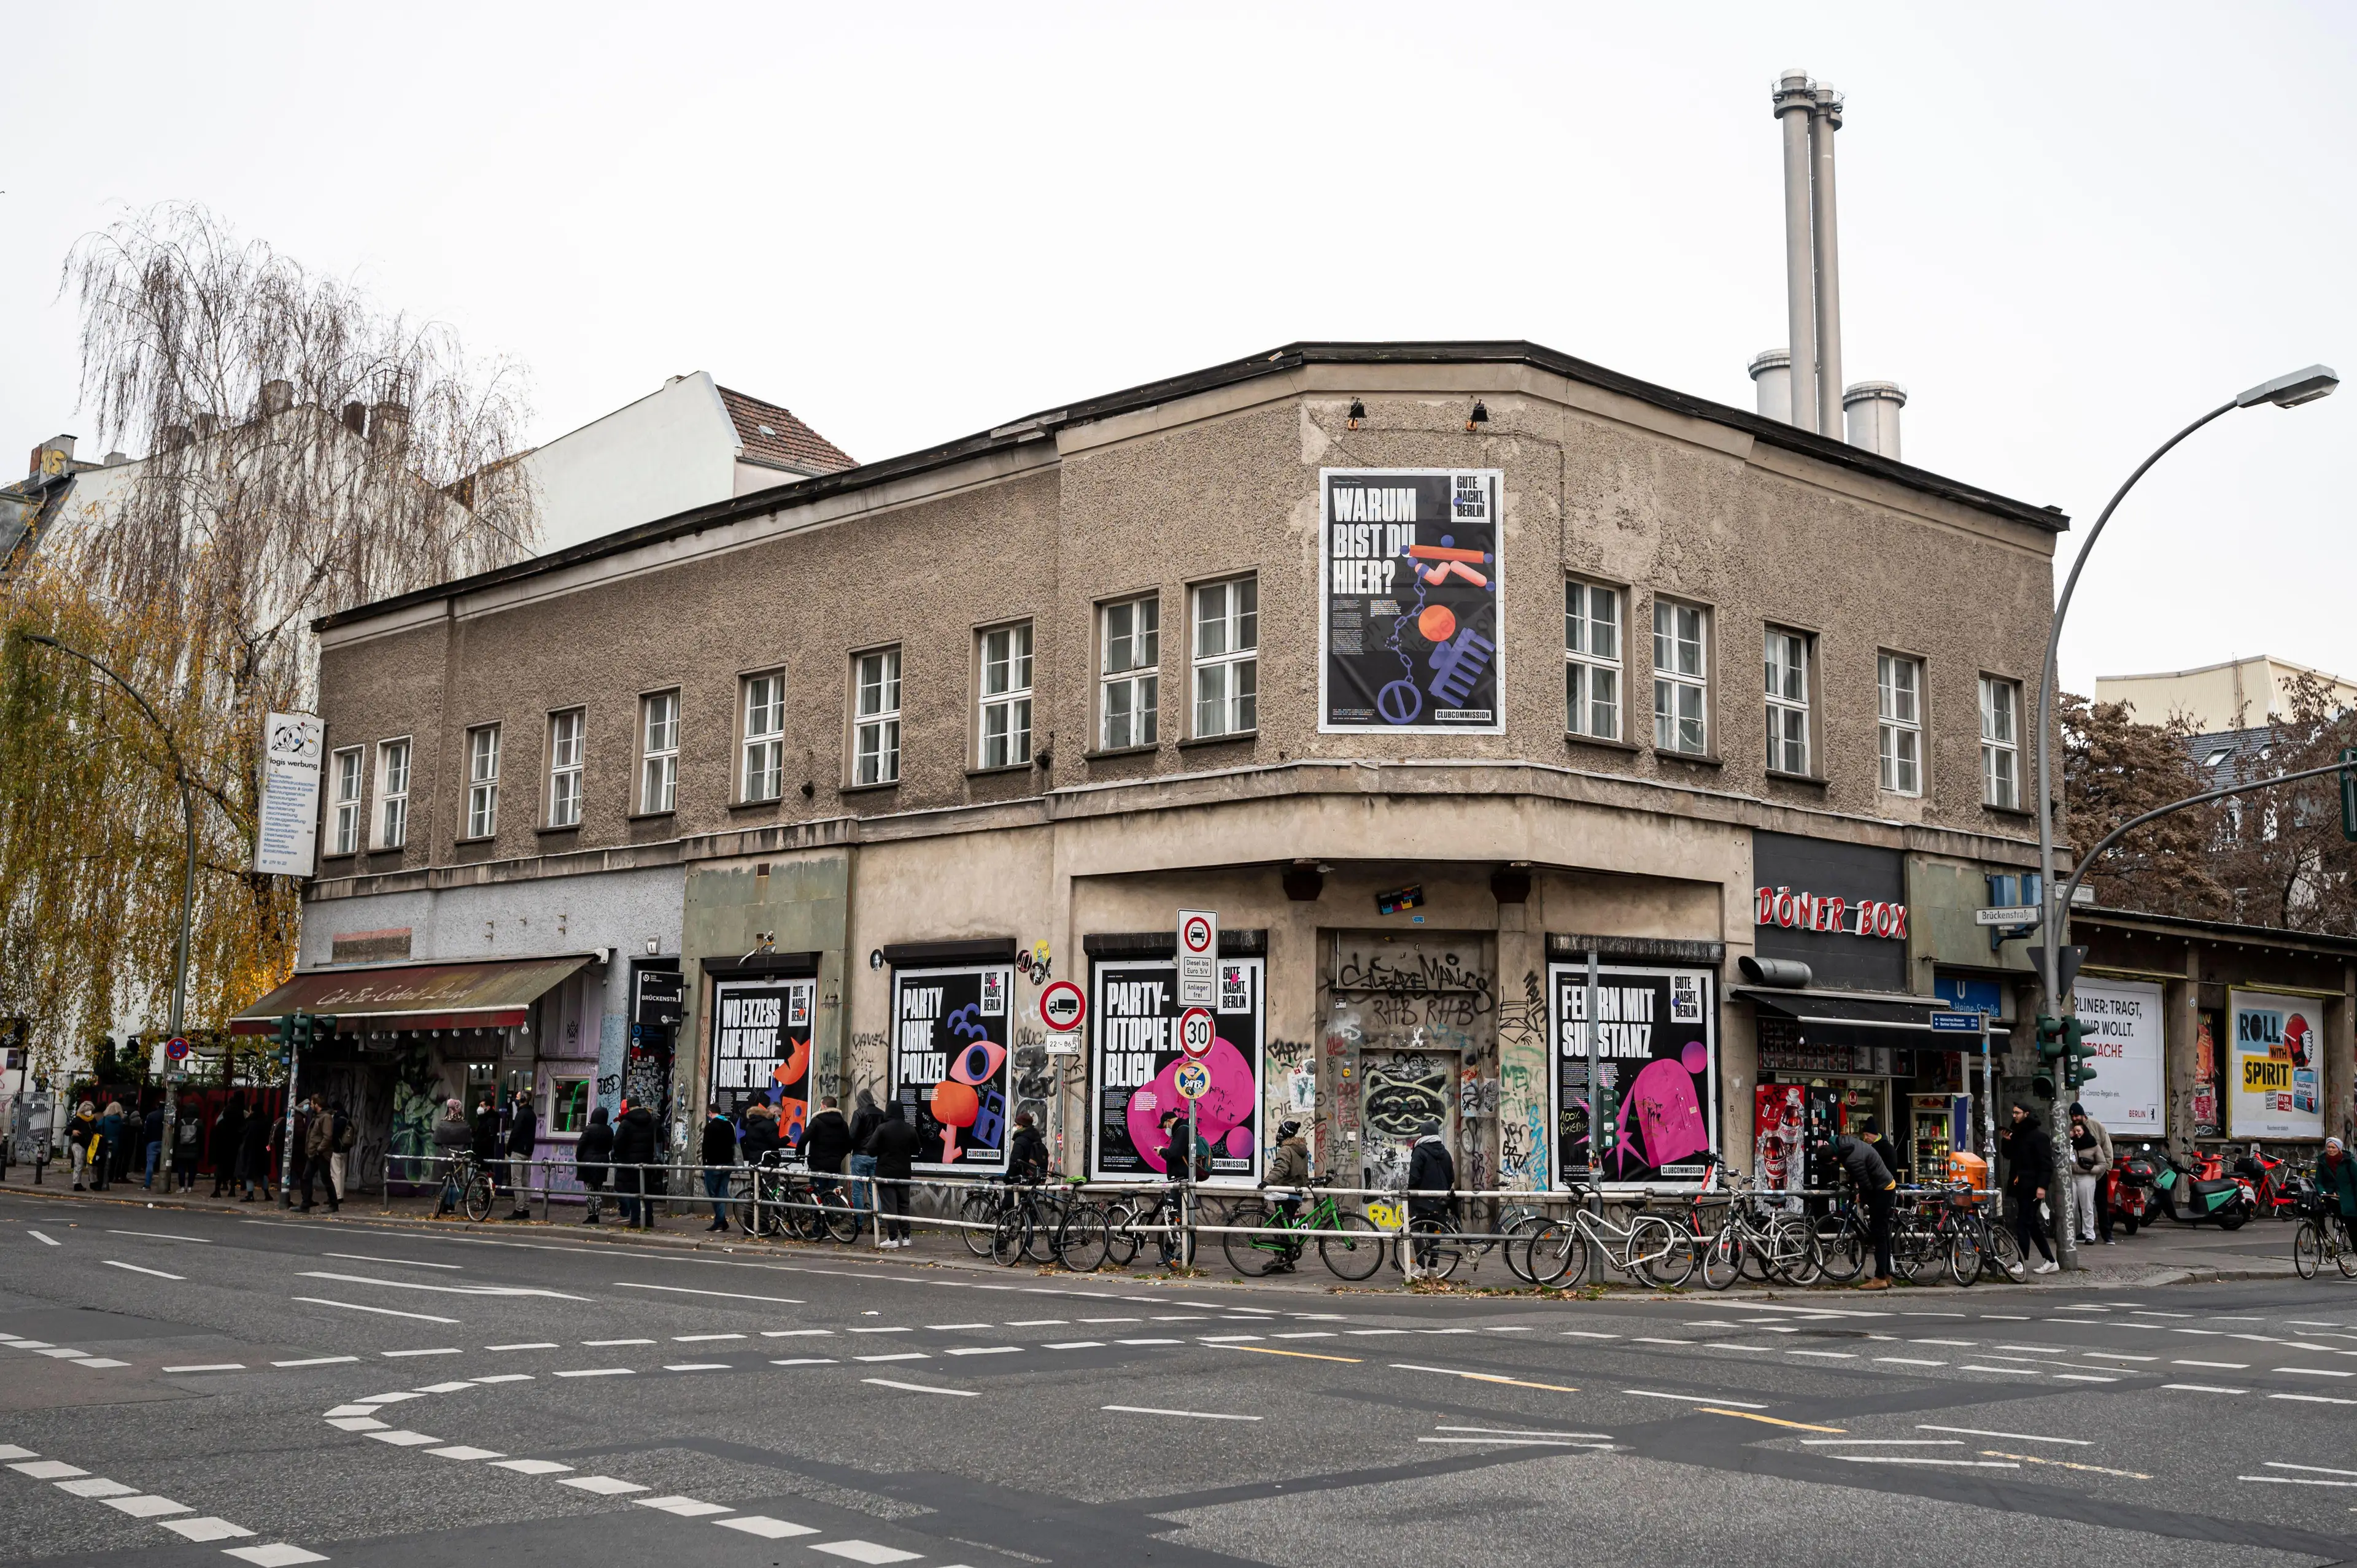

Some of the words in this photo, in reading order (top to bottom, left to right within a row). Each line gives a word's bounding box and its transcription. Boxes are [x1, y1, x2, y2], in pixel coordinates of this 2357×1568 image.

[1457, 476, 1477, 489] GUTE
[1457, 490, 1484, 504] NACHT,
[1333, 488, 1416, 522] WARUM
[1457, 504, 1484, 517] BERLIN
[1333, 523, 1382, 558] BIST
[1387, 523, 1415, 558] DU
[1333, 560, 1396, 594] HIER?
[1436, 710, 1490, 719] CLUBCOMMISSION
[270, 757, 285, 767] logis
[287, 760, 317, 770] werbung
[1755, 886, 1846, 933] DÖNER
[1855, 900, 1907, 940] BOX
[1982, 911, 2033, 922] Brückenstraße
[985, 972, 997, 984] GUTE
[1223, 967, 1240, 979] GUTE
[1187, 984, 1208, 992] Anlieger
[1223, 981, 1247, 995] NACHT,
[1674, 976, 1691, 989] GUTE
[1957, 980, 1965, 1000] U
[641, 994, 678, 1003] BRÜCKENSTR.
[676, 988, 682, 1002] 1
[792, 986, 804, 998] GUTE
[984, 985, 1001, 998] NACHT,
[1107, 982, 1170, 1016] PARTY-
[1675, 990, 1698, 1005] NACHT,
[792, 998, 807, 1010] NACHT,
[902, 987, 943, 1019] PARTY
[984, 998, 1001, 1011] BERLIN
[1223, 995, 1247, 1009] BERLIN
[1562, 985, 1620, 1021] FEIRN
[1623, 987, 1655, 1022] MIT
[723, 999, 741, 1028] WO
[741, 998, 781, 1027] EXZESS
[1675, 1003, 1698, 1018] BERLIN
[2110, 1000, 2142, 1020] TRAGT,
[901, 1020, 934, 1052] OHNE
[1106, 1017, 1168, 1051] UTOPIE
[1187, 1021, 1207, 1045] 30
[2102, 1021, 2134, 1037] WOLLT.
[720, 1029, 742, 1057] AUF
[741, 1029, 781, 1057] NACHT-
[1562, 1022, 1652, 1058] SUSTANZ
[2081, 1042, 2123, 1058] ACHE
[2270, 1046, 2287, 1059] WITH
[719, 1059, 748, 1088] RUHE
[900, 1052, 947, 1084] POLIZEI
[1105, 1053, 1156, 1087] BLICK
[2245, 1060, 2289, 1087] SPIRIT
[2086, 1089, 2113, 1099] Corona-Regeln
[2129, 1110, 2146, 1118] BERLIN
[1662, 1165, 1705, 1175] CLUBCOMMISSION
[1765, 1159, 1786, 1170] Coca-Cola
